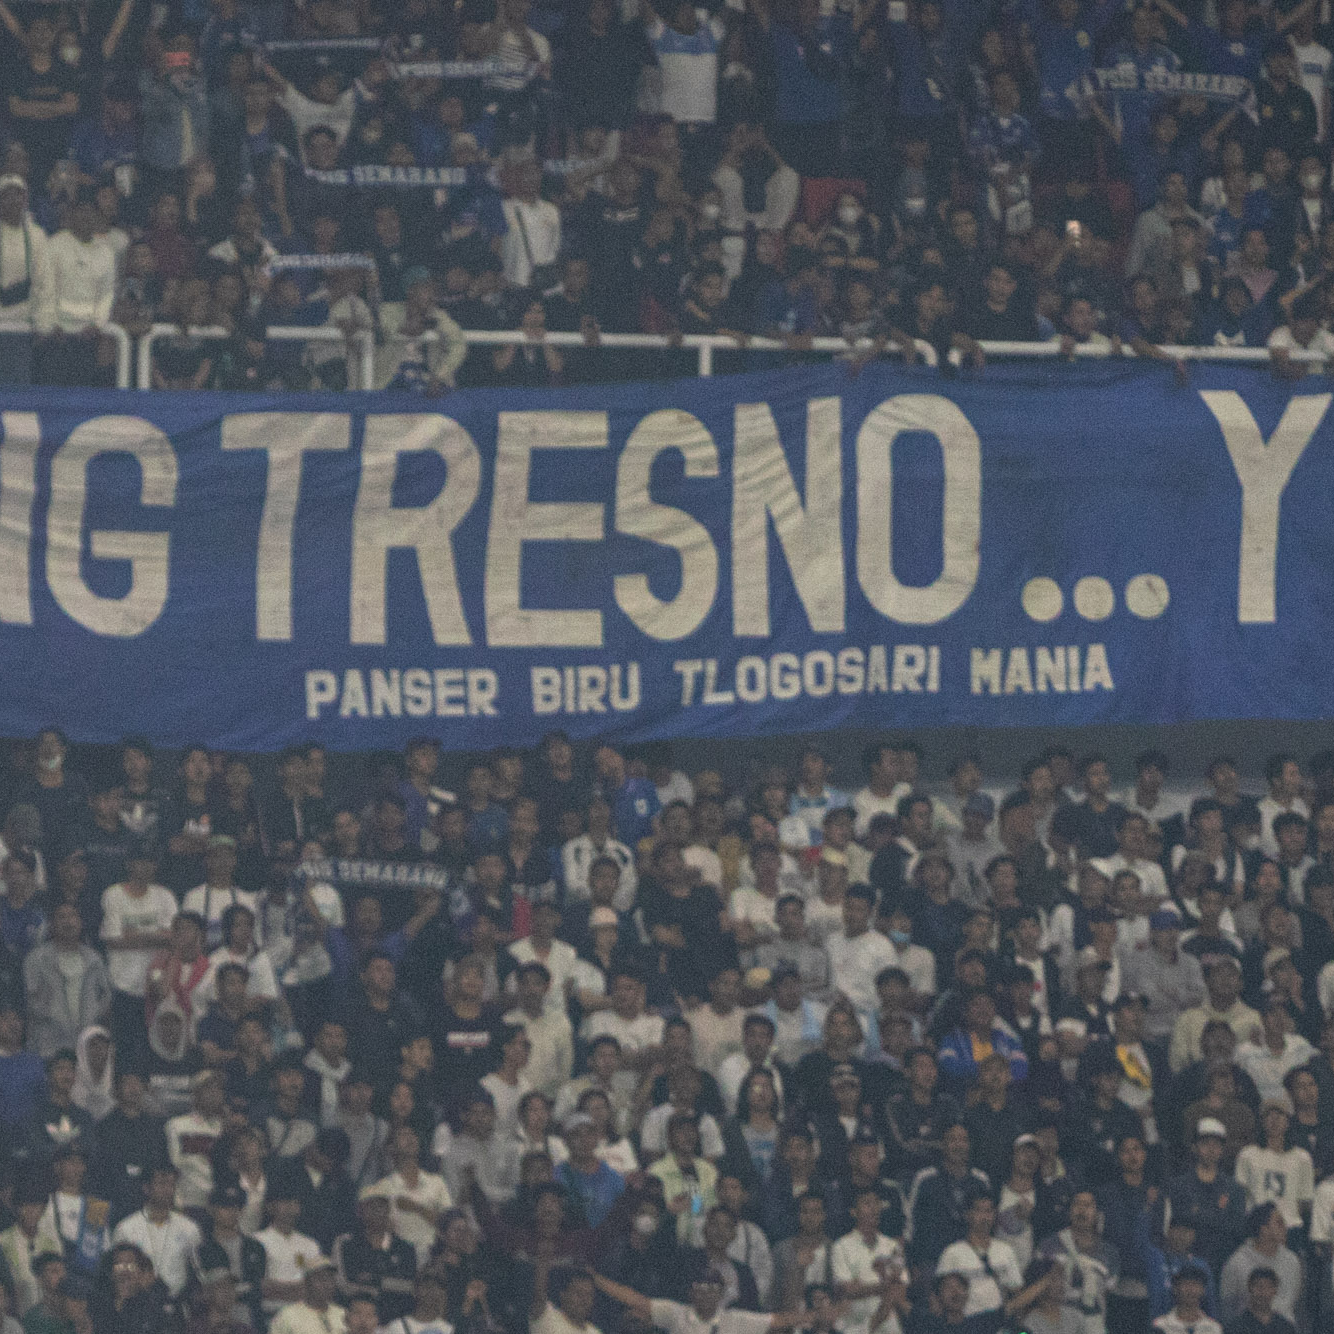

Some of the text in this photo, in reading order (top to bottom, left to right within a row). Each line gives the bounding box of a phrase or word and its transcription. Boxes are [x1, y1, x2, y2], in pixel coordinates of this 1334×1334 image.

[221, 392, 983, 648] TRESNO
[305, 642, 1114, 721] PANSER BIRU TLOGOSARI MANIA
